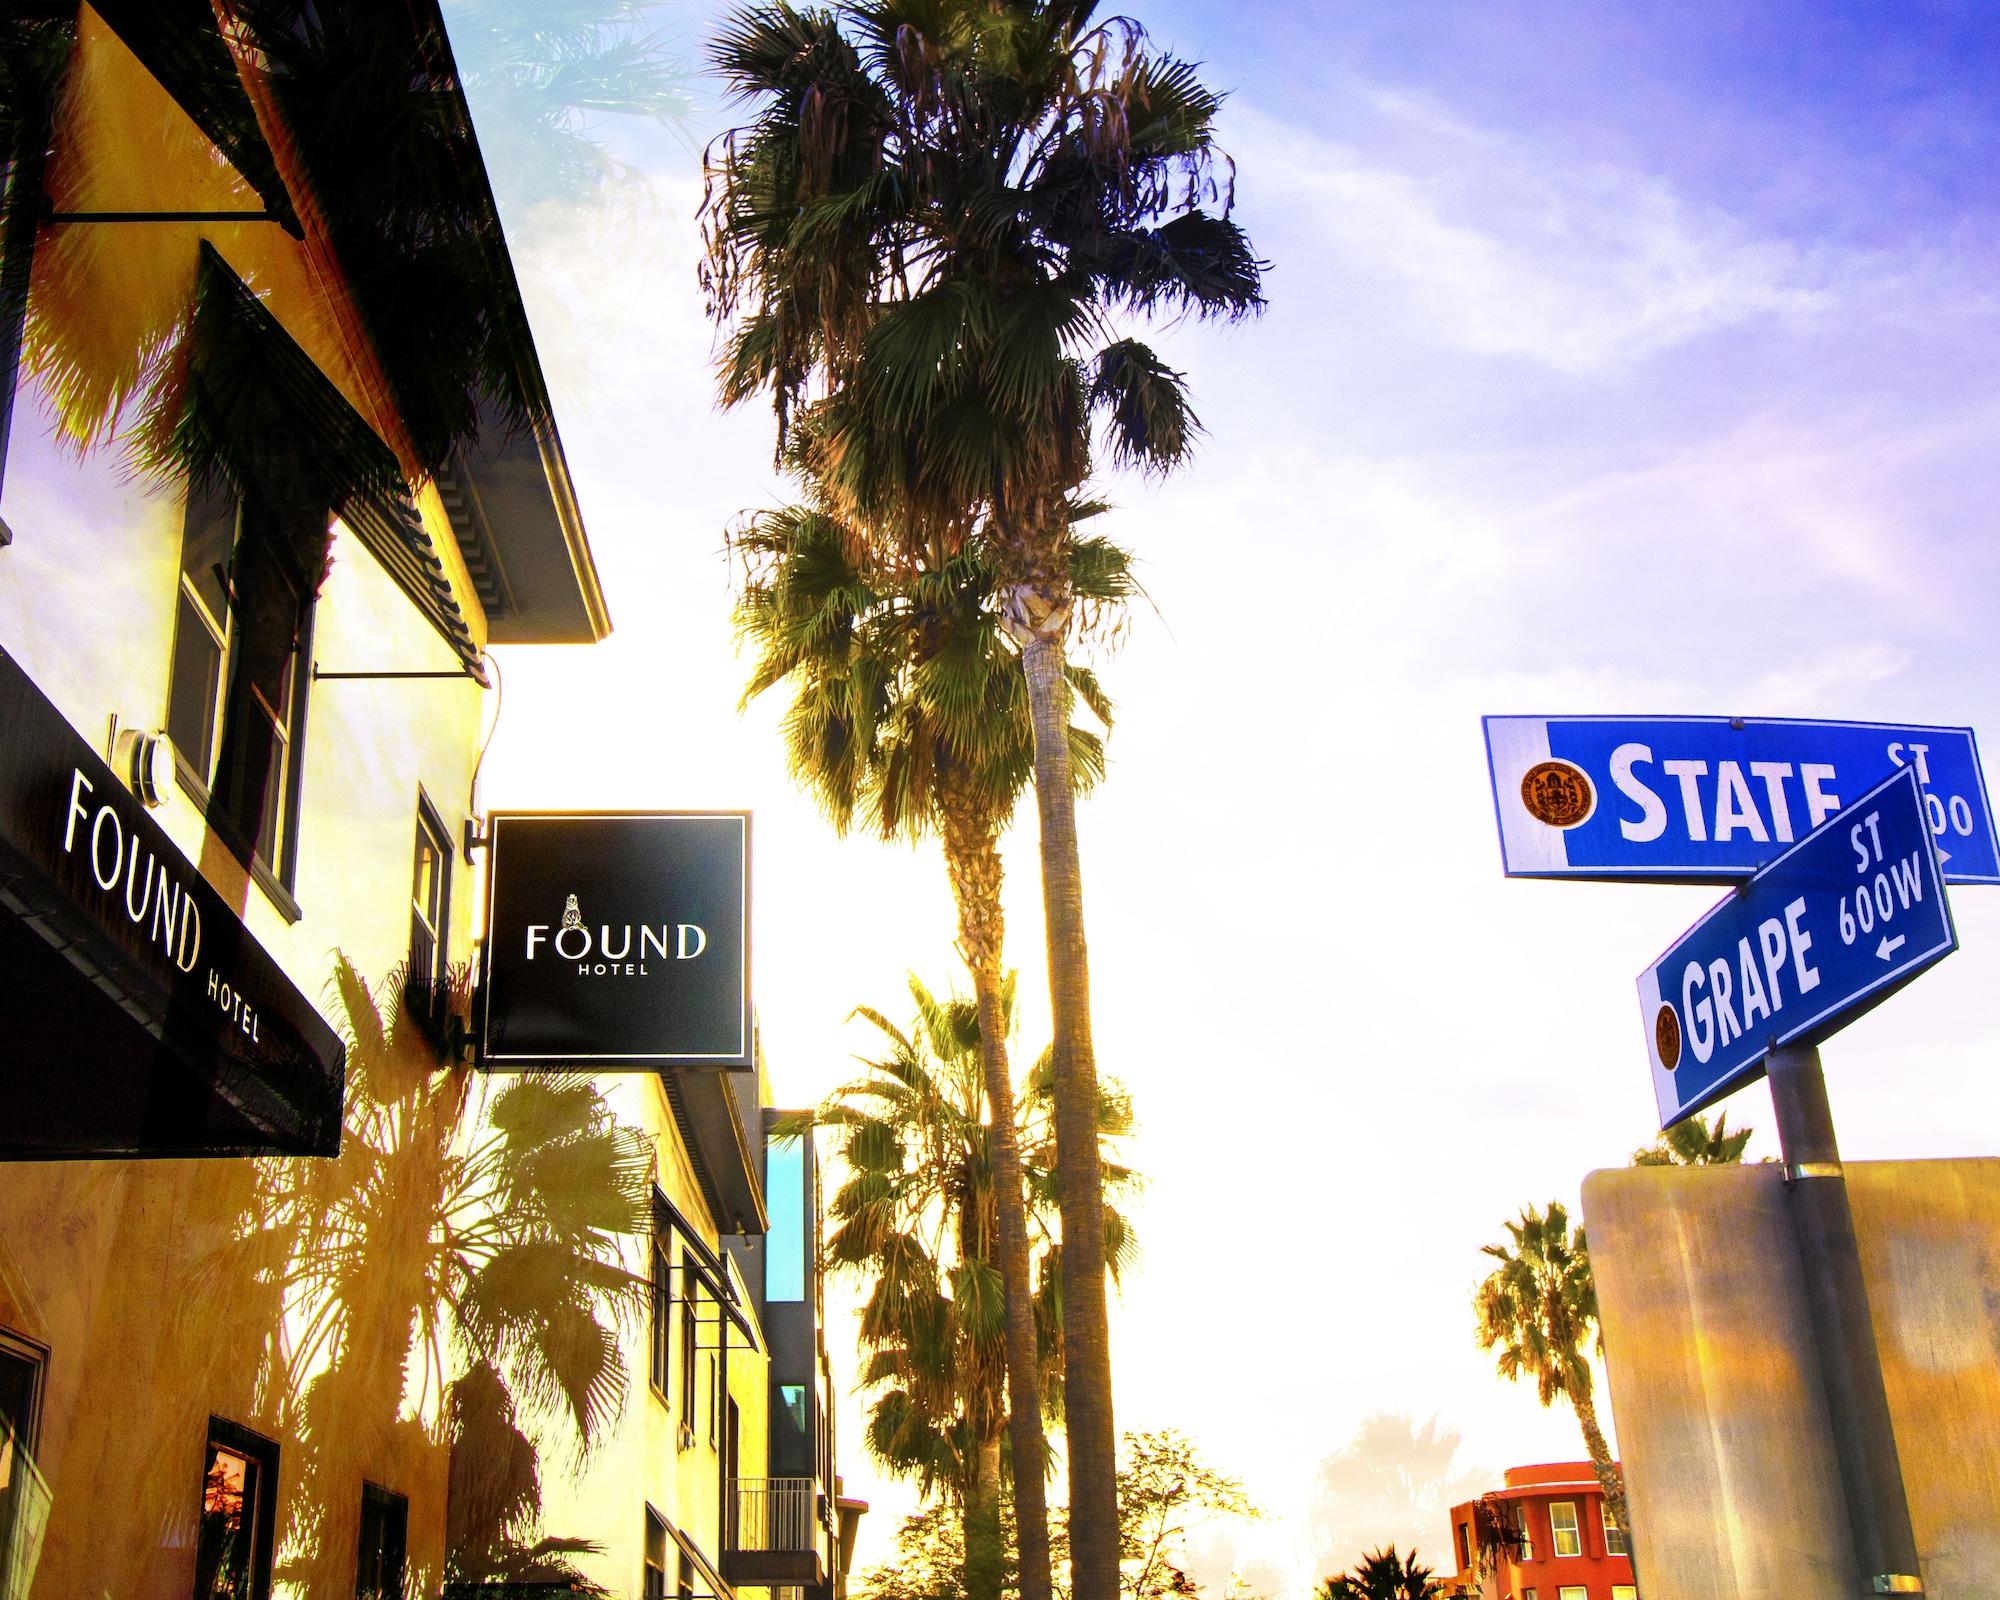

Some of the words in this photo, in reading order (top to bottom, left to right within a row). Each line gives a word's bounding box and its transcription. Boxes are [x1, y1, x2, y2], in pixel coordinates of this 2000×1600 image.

[1887, 742, 1931, 785] ST
[64, 767, 201, 973] FOUND
[207, 968, 260, 1044] HOTEL
[525, 924, 708, 960] FOUND
[1682, 896, 1821, 1064] GRAPE
[1851, 811, 1883, 874] ST
[578, 963, 649, 976] HOTEL
